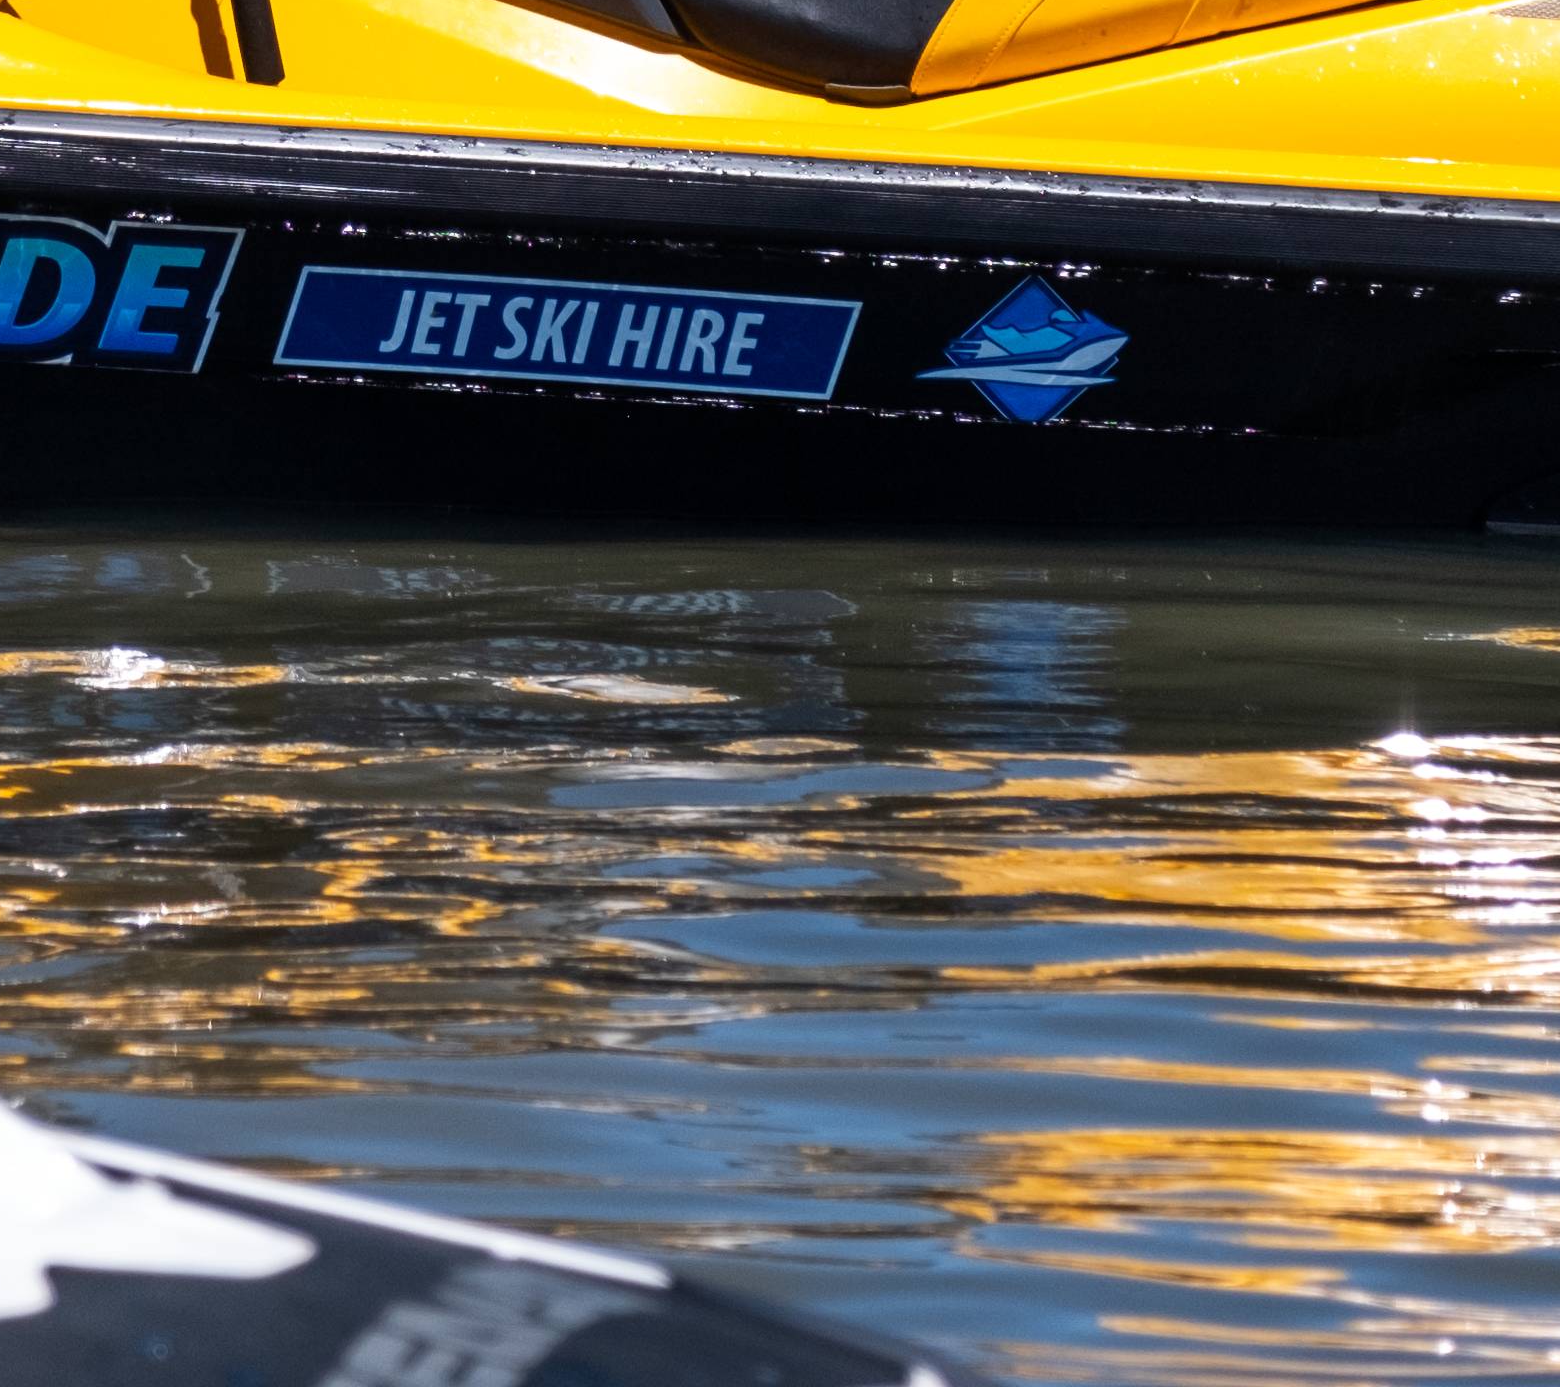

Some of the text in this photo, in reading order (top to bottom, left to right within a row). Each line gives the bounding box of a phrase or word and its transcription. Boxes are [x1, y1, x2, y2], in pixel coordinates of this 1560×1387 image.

[378, 289, 765, 376] JET SKI HIRE
